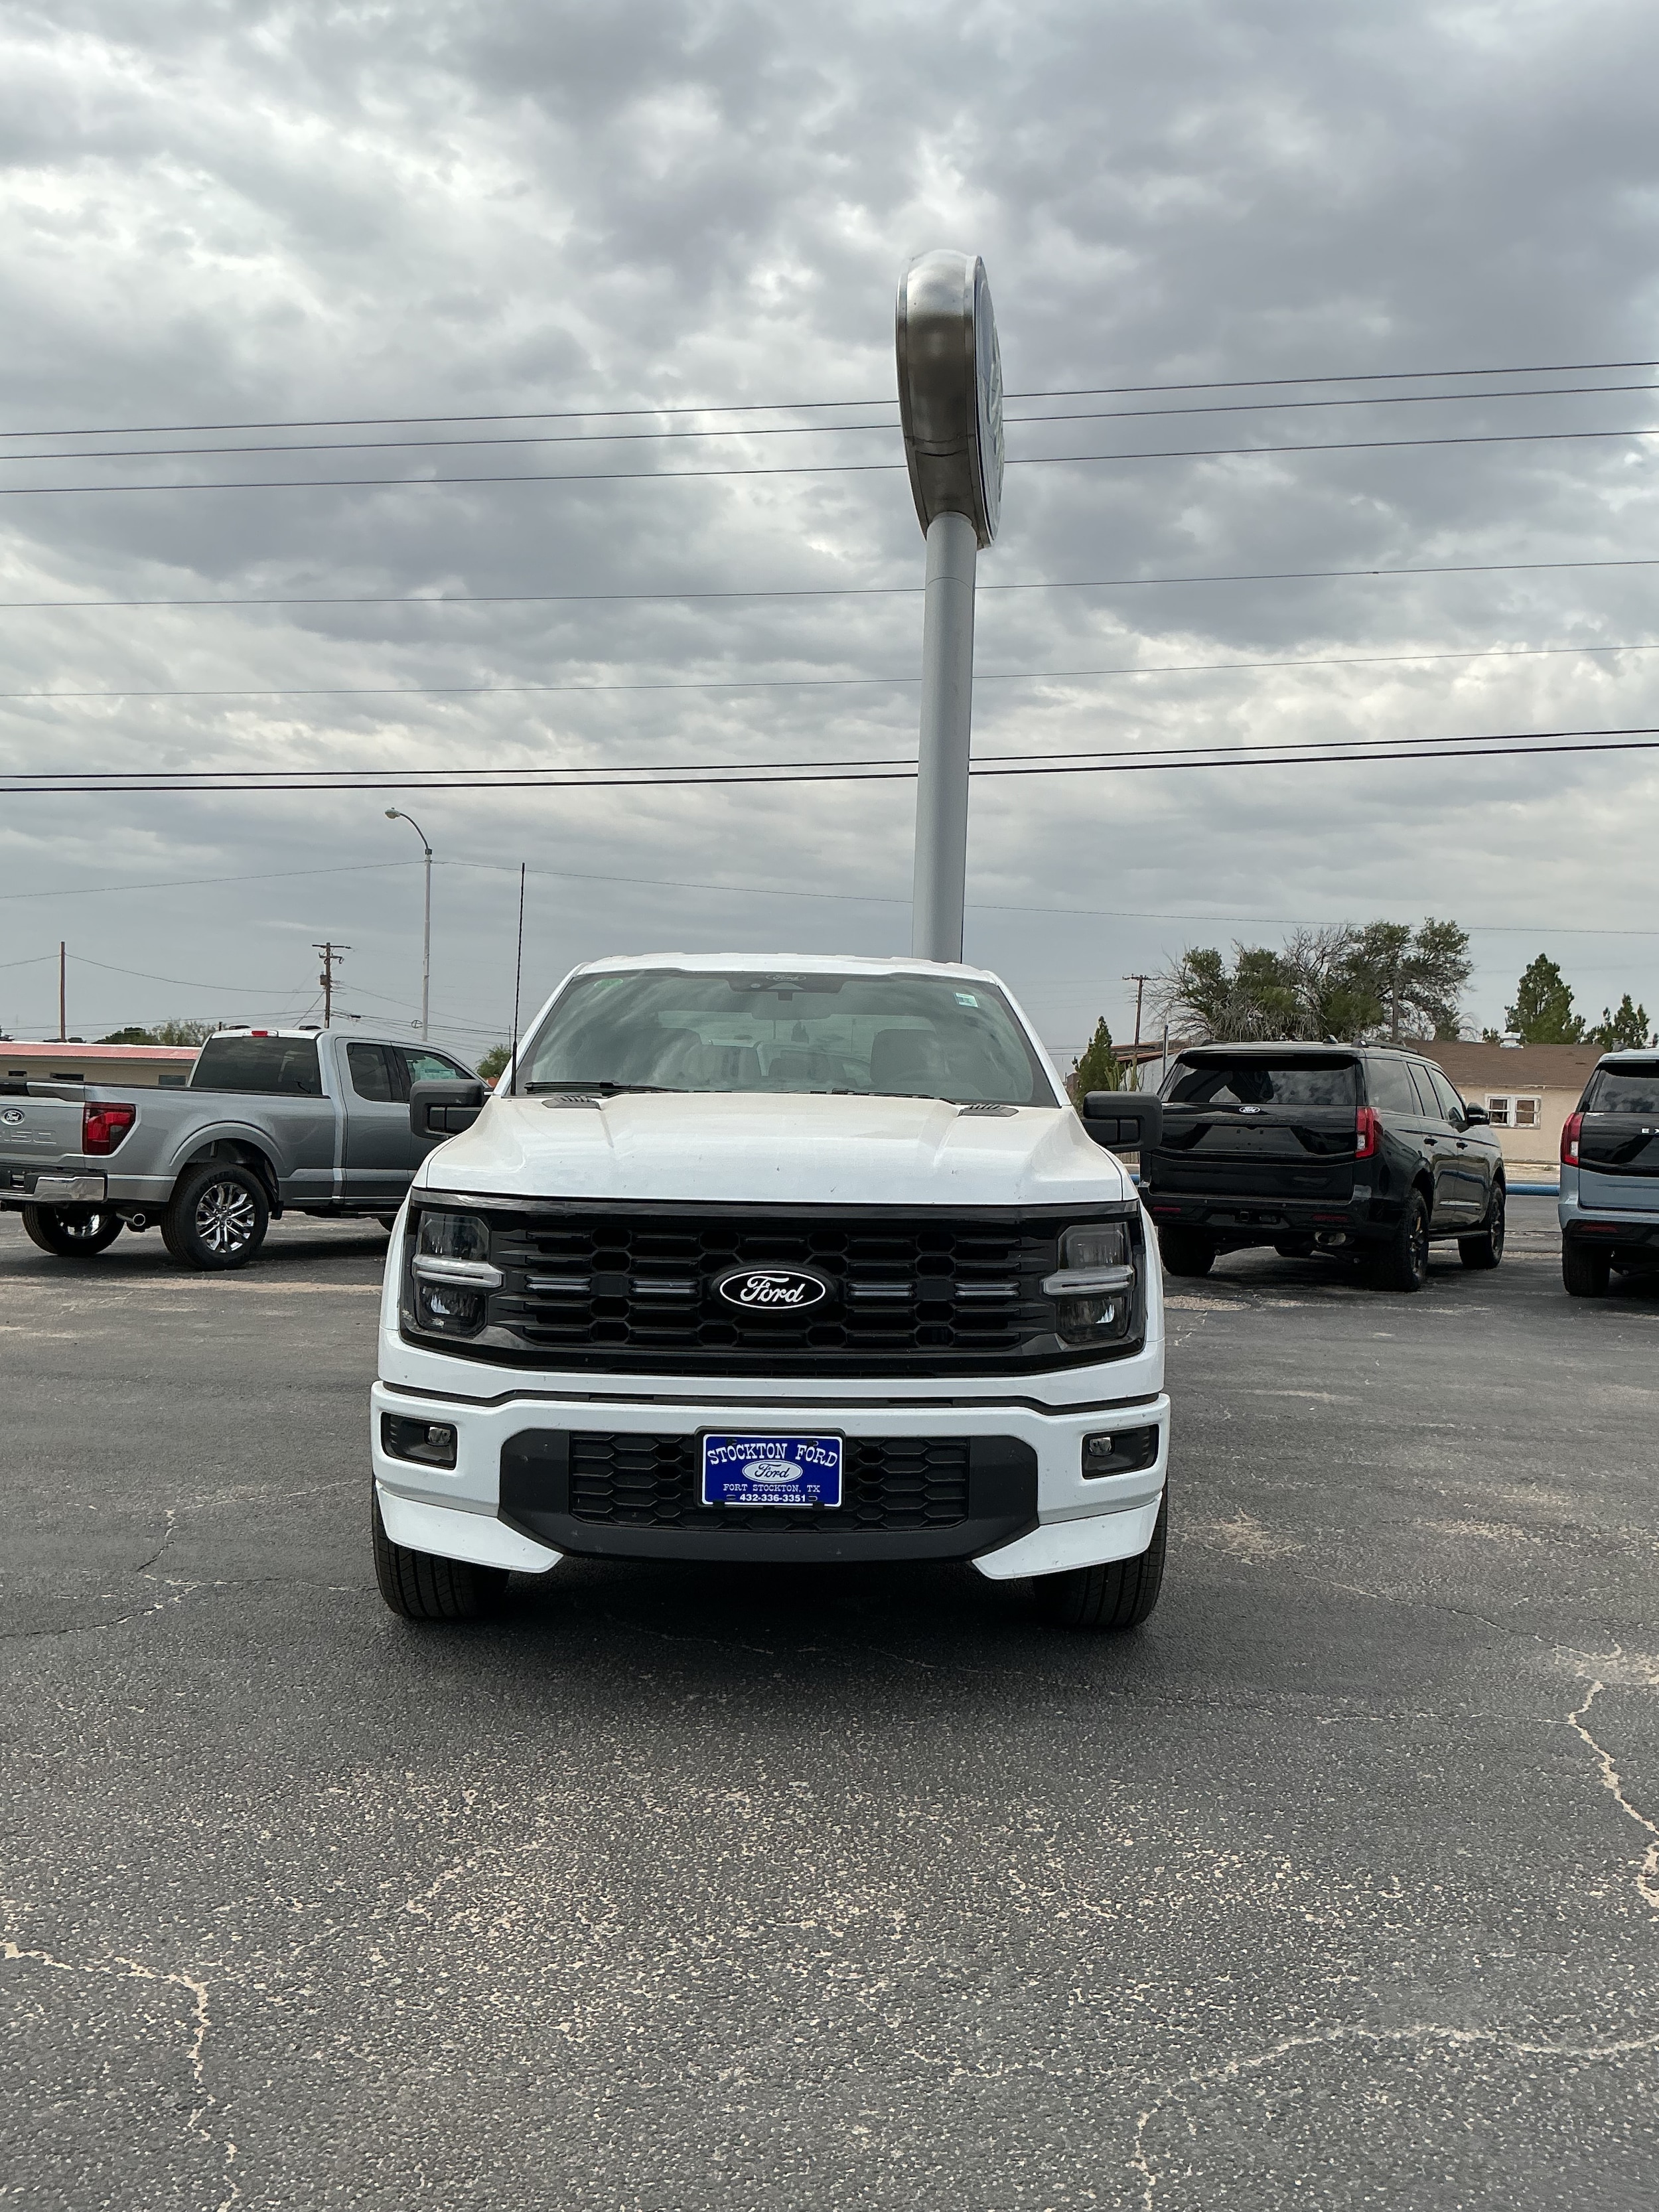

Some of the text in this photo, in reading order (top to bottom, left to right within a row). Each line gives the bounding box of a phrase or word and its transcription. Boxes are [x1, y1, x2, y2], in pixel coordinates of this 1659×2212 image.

[740, 1276, 806, 1302] Ford
[707, 1443, 838, 1467] STOCKTON FORD
[755, 1463, 790, 1478] Ford
[753, 1484, 802, 1493] STOCKTON,
[739, 1493, 806, 1502] 432-336-3351
